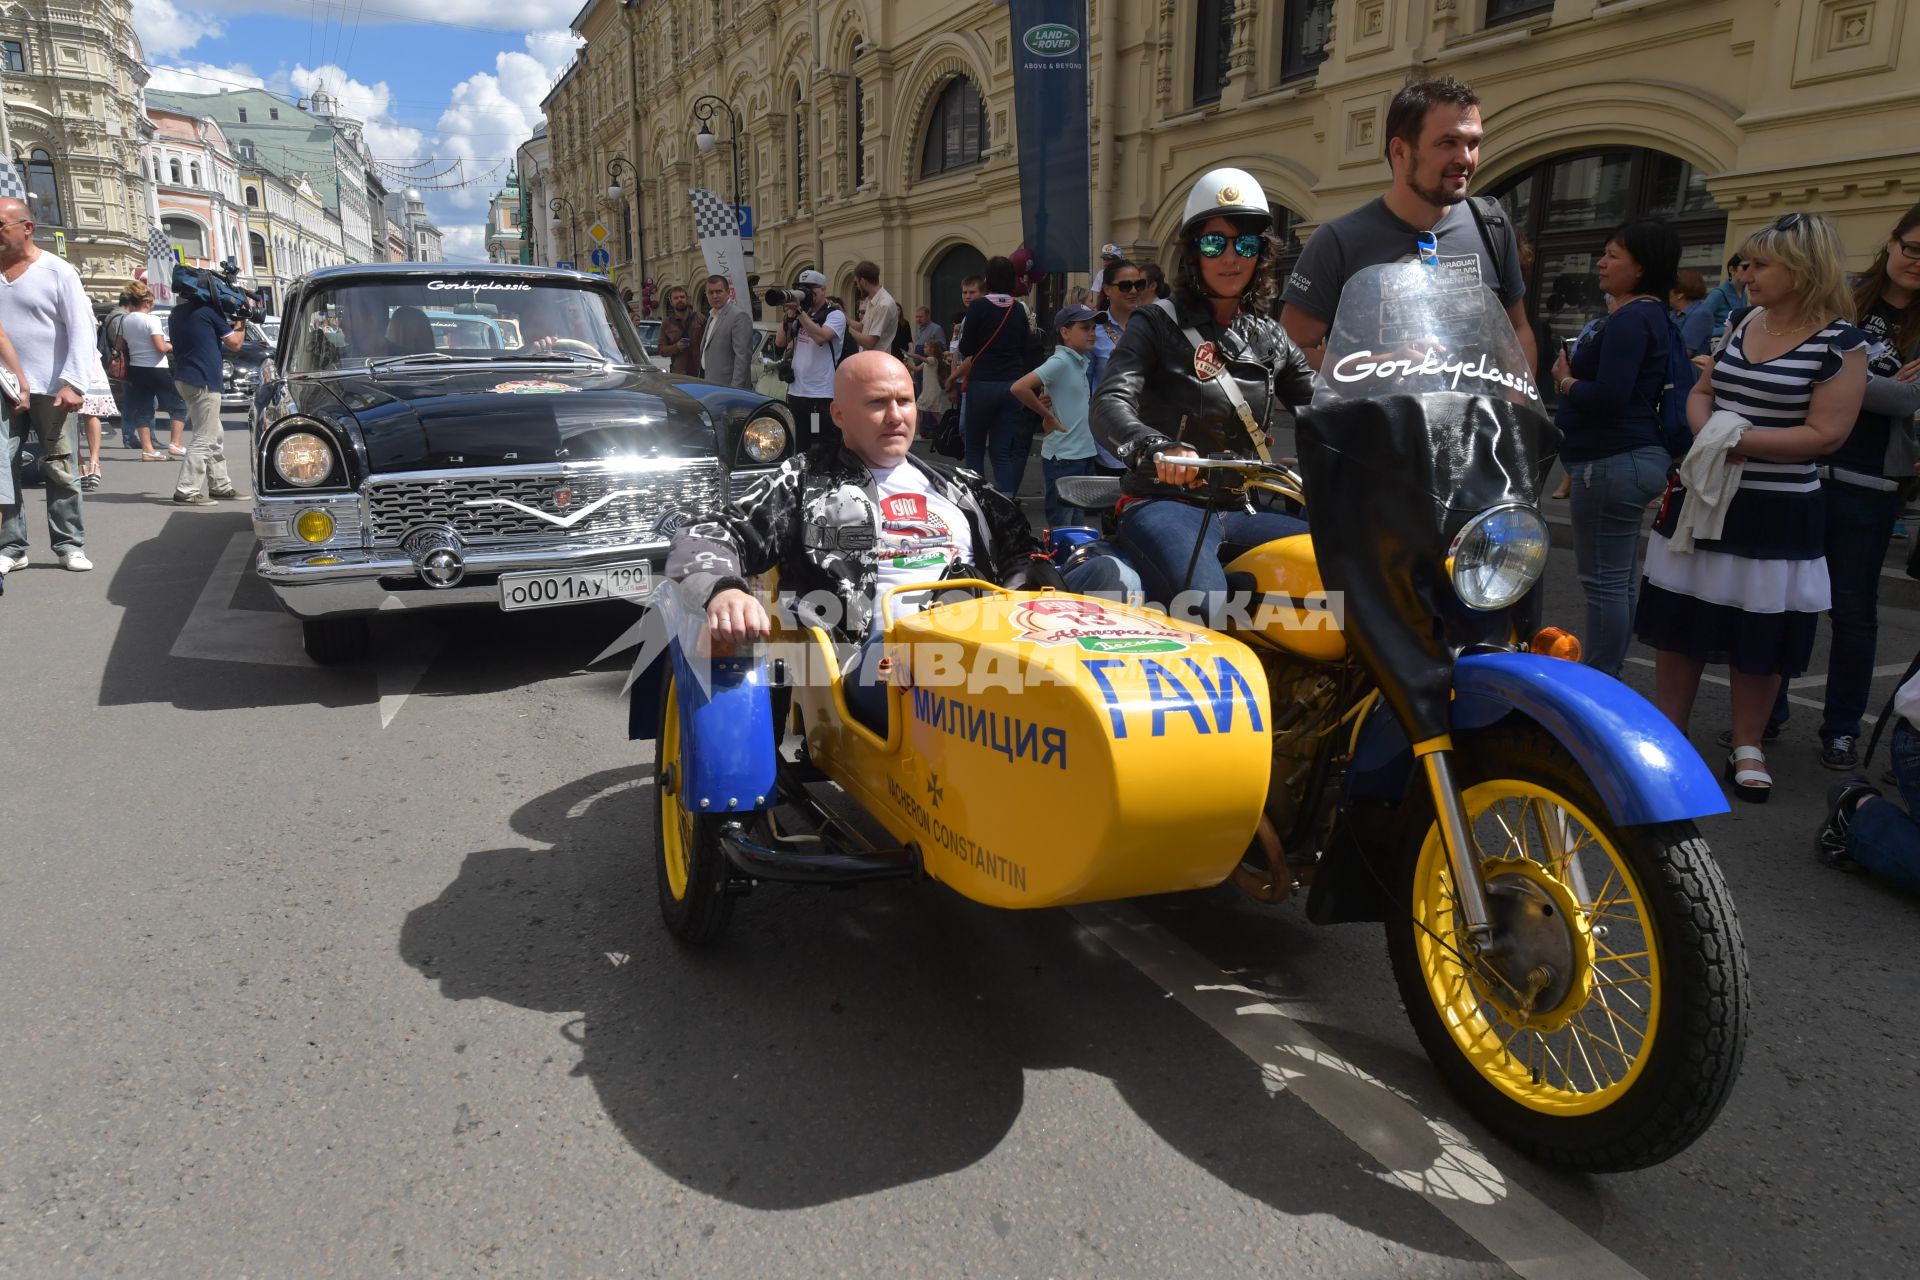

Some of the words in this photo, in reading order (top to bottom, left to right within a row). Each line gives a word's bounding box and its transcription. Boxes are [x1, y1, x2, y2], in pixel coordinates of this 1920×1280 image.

[1035, 30, 1063, 40] LAND
[1037, 39, 1071, 49] ROVER
[1024, 62, 1047, 70] ABOVE
[1048, 62, 1054, 70] &
[427, 280, 532, 295] Gorkyclassic
[1332, 347, 1539, 401] Gorkyclassic
[610, 567, 644, 588] 190
[618, 584, 636, 593] RUS
[1057, 611, 1117, 626] 13
[1080, 656, 1264, 739] ГАИ
[914, 685, 1067, 770] МИЛИЦИЯ
[887, 773, 931, 834] VACHERON
[932, 818, 1027, 893] CONSTANTIN
